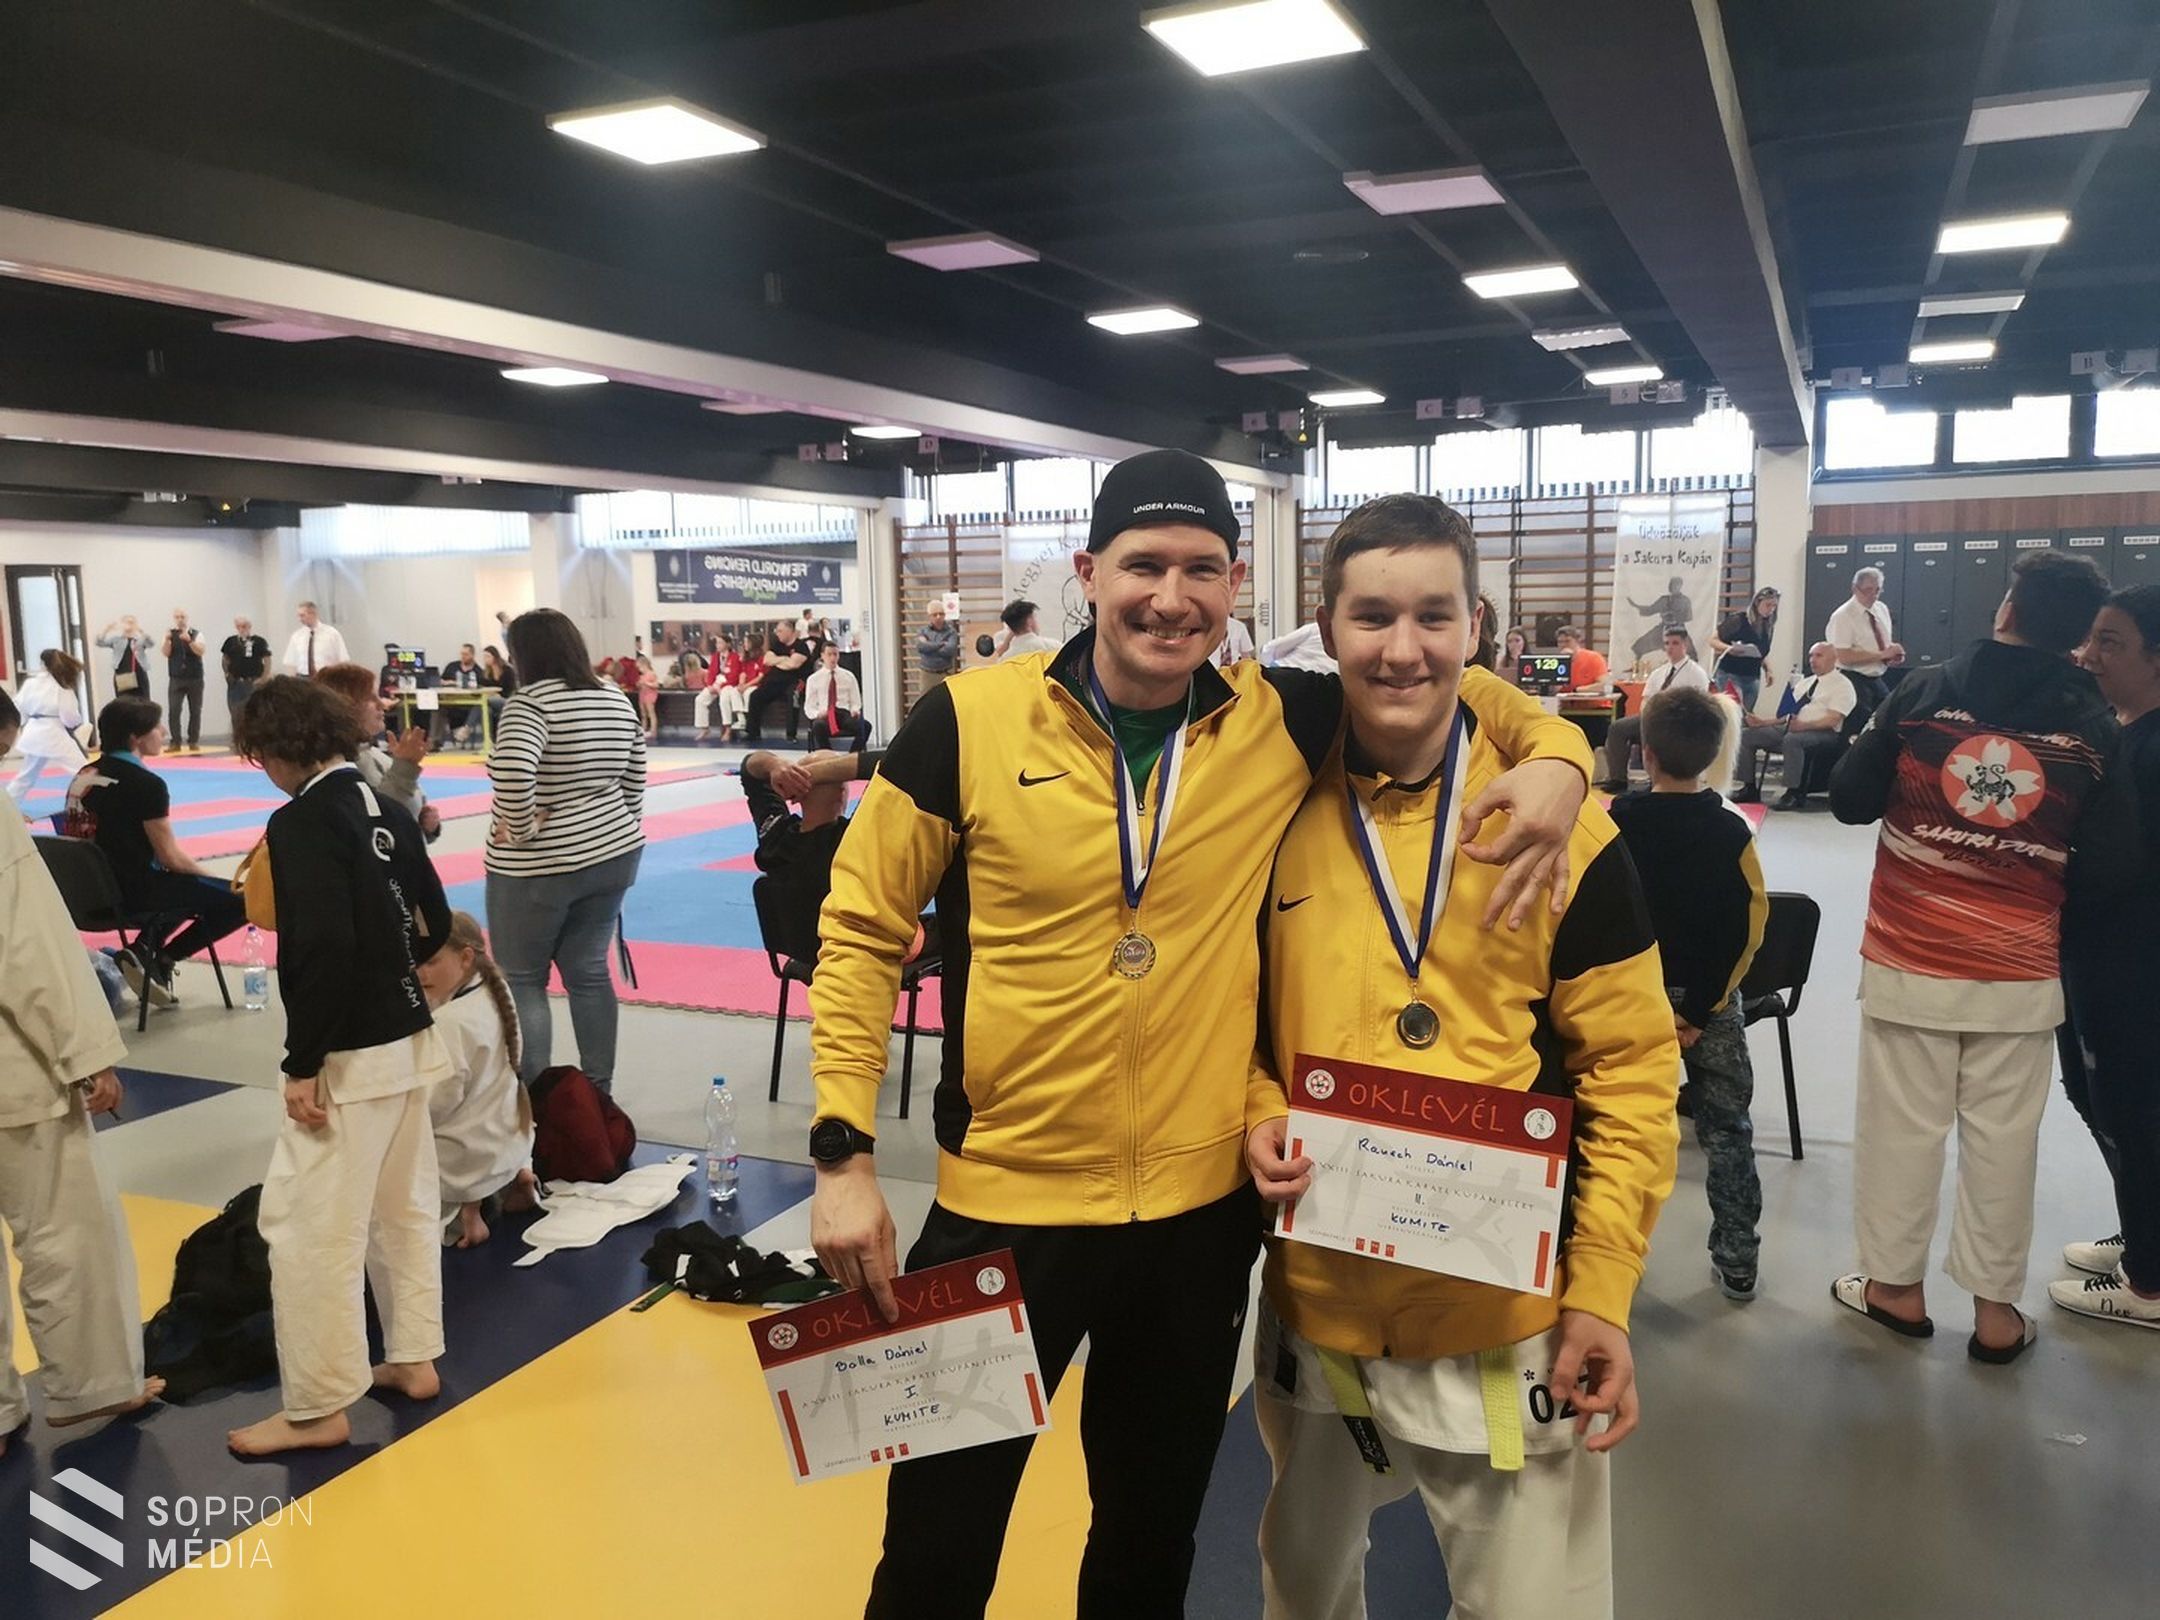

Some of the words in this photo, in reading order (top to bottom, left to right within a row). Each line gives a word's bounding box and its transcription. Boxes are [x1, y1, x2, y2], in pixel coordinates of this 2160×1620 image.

[1133, 502, 1164, 514] UNDER
[1165, 502, 1206, 515] ARMOUR
[1622, 554, 1629, 564] a
[1557, 664, 1566, 675] 0
[1350, 1082, 1505, 1133] OKLEVÉL
[1426, 1153, 1474, 1172] Dániel
[1390, 1212, 1450, 1233] KUMITE
[812, 1279, 963, 1339] OKLVÉL
[885, 1340, 928, 1361] Dániel
[884, 1403, 940, 1426] KUMITE
